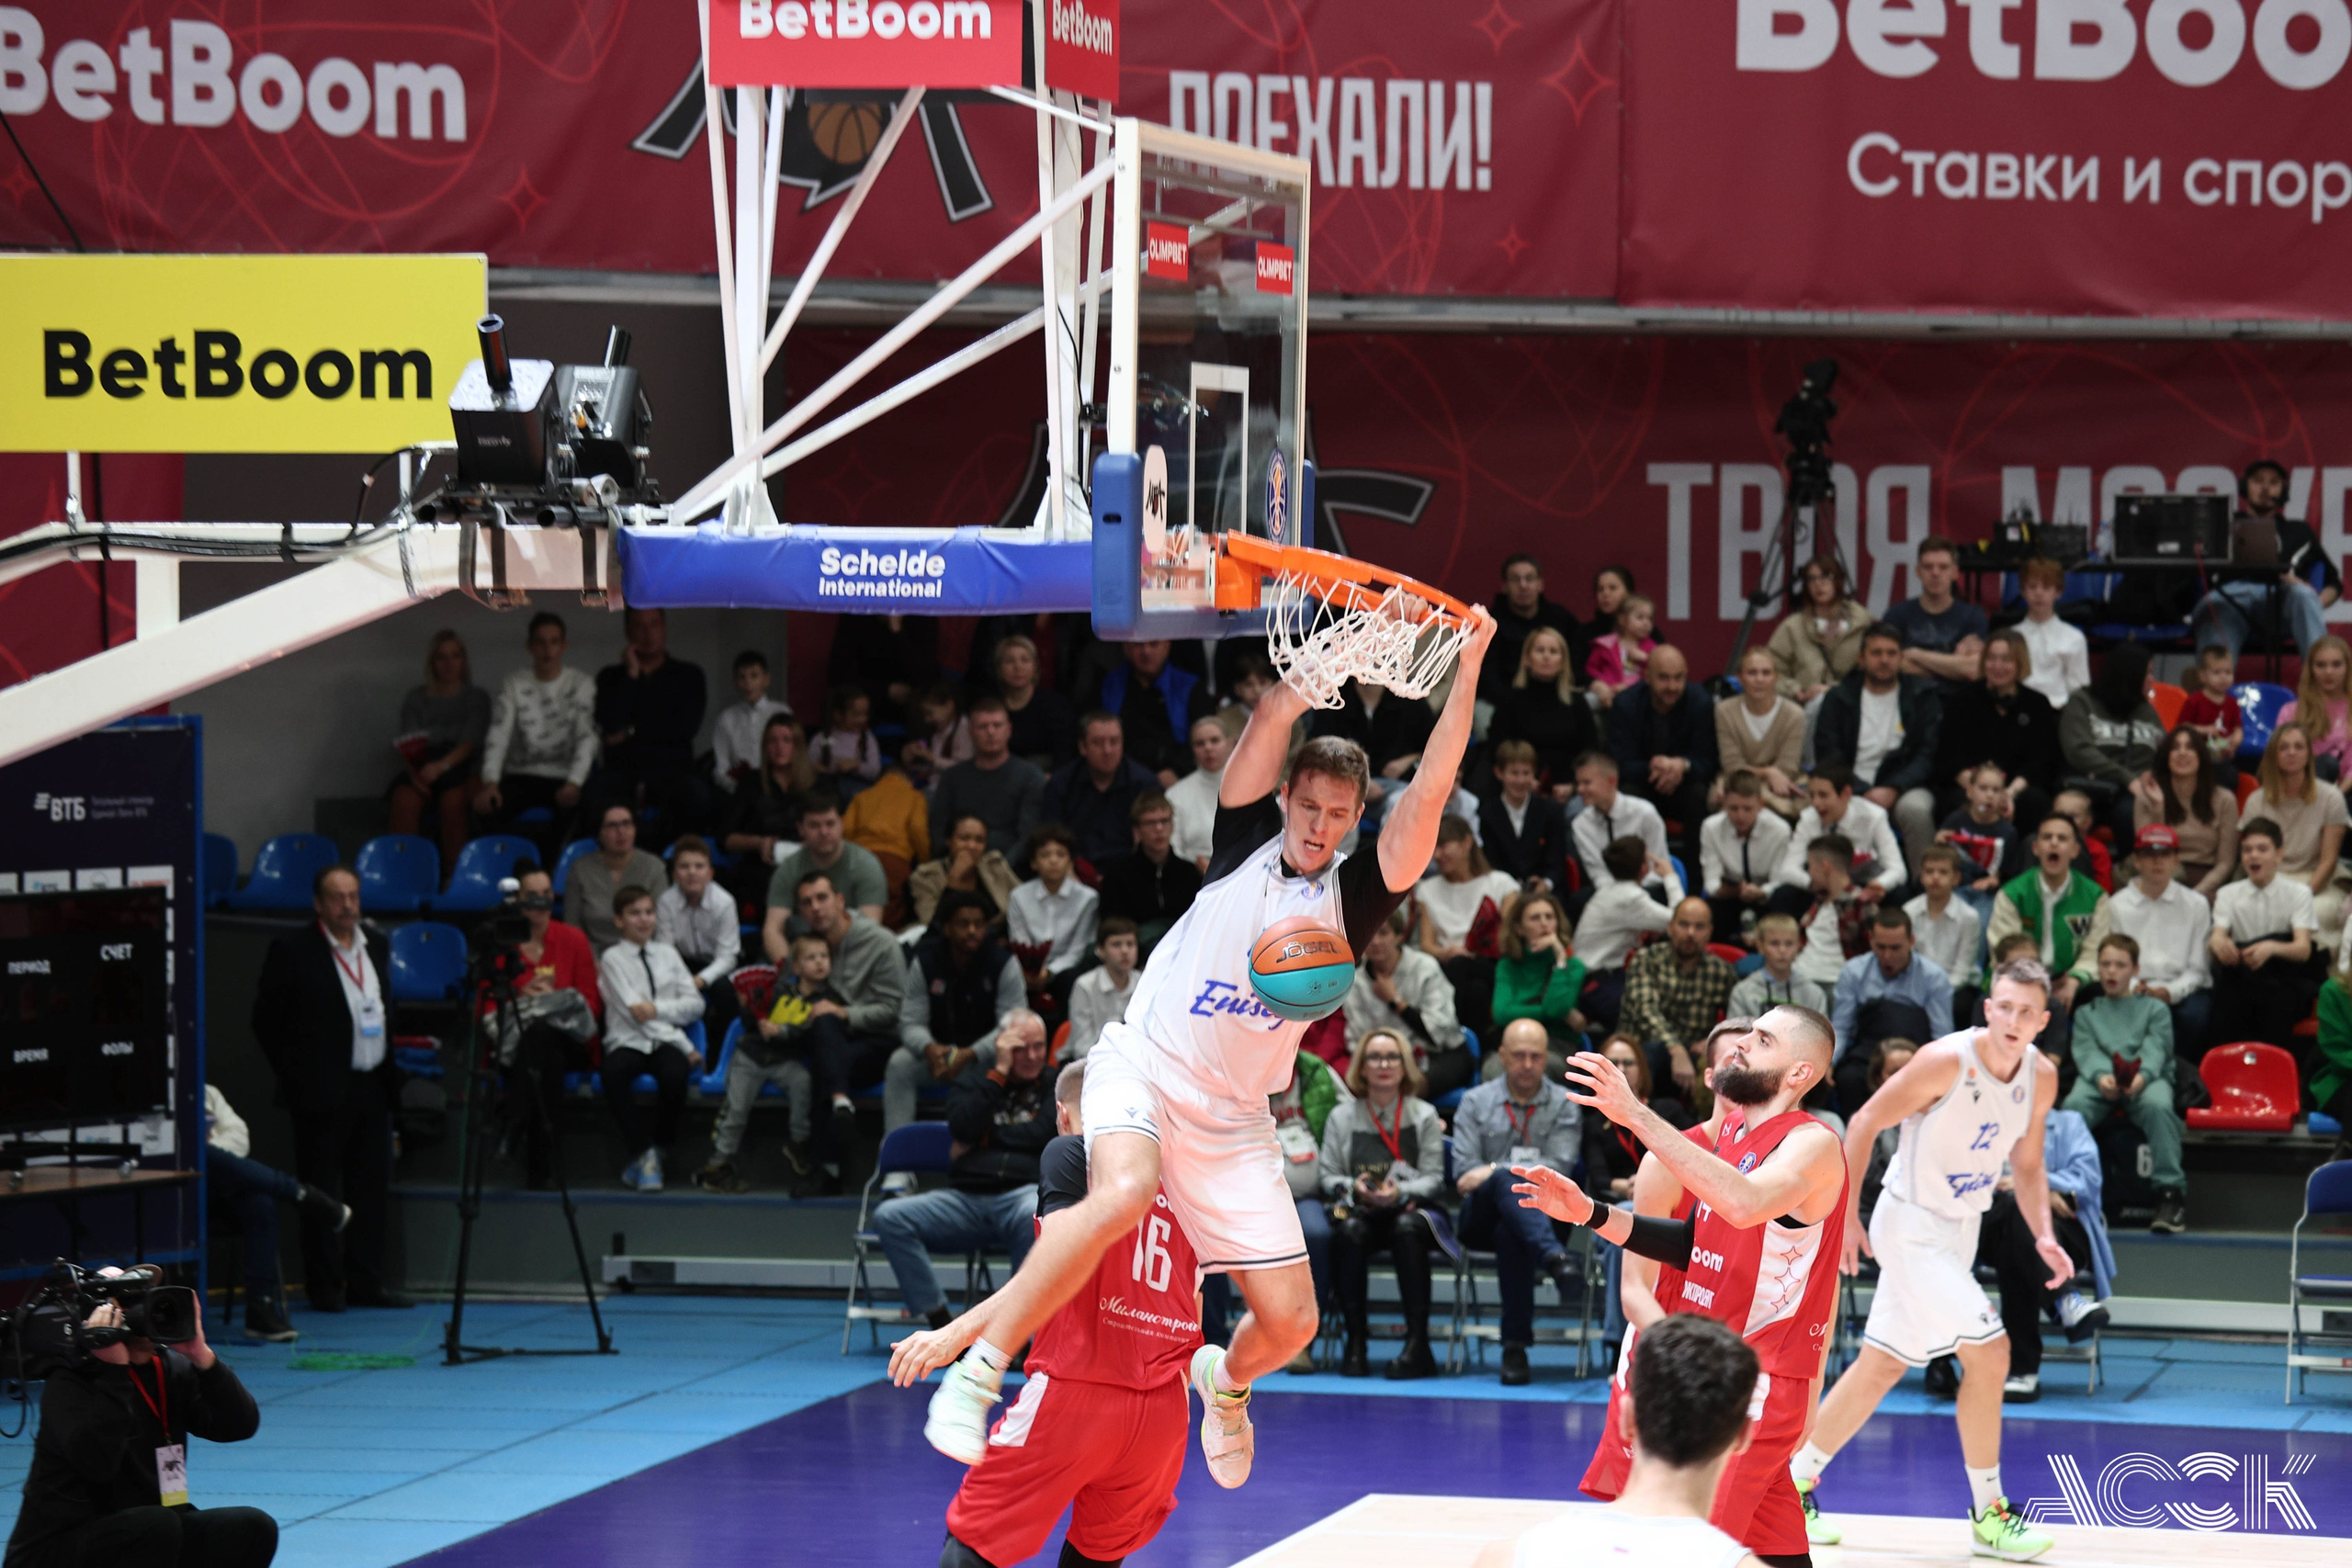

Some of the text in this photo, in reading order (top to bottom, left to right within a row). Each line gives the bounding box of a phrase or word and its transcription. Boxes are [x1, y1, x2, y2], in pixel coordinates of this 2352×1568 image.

[740, 0, 991, 39] BetBoom
[1052, 0, 1113, 55] BetBoom
[0, 7, 466, 141] BetBoom
[1170, 70, 1493, 191] ПОЕХАЛИ!
[1848, 132, 2352, 223] Ставки и спор
[1148, 237, 1188, 266] OLIMPBET
[1258, 254, 1294, 283] OLIMPBET
[44, 328, 433, 400] BetBoom
[820, 547, 946, 578] Schelde
[819, 577, 943, 598] International
[100, 942, 133, 961] СЧЕТ
[2136, 1144, 2153, 1178] 6
[1132, 1213, 1172, 1293] 16
[1690, 1246, 1724, 1272] oom
